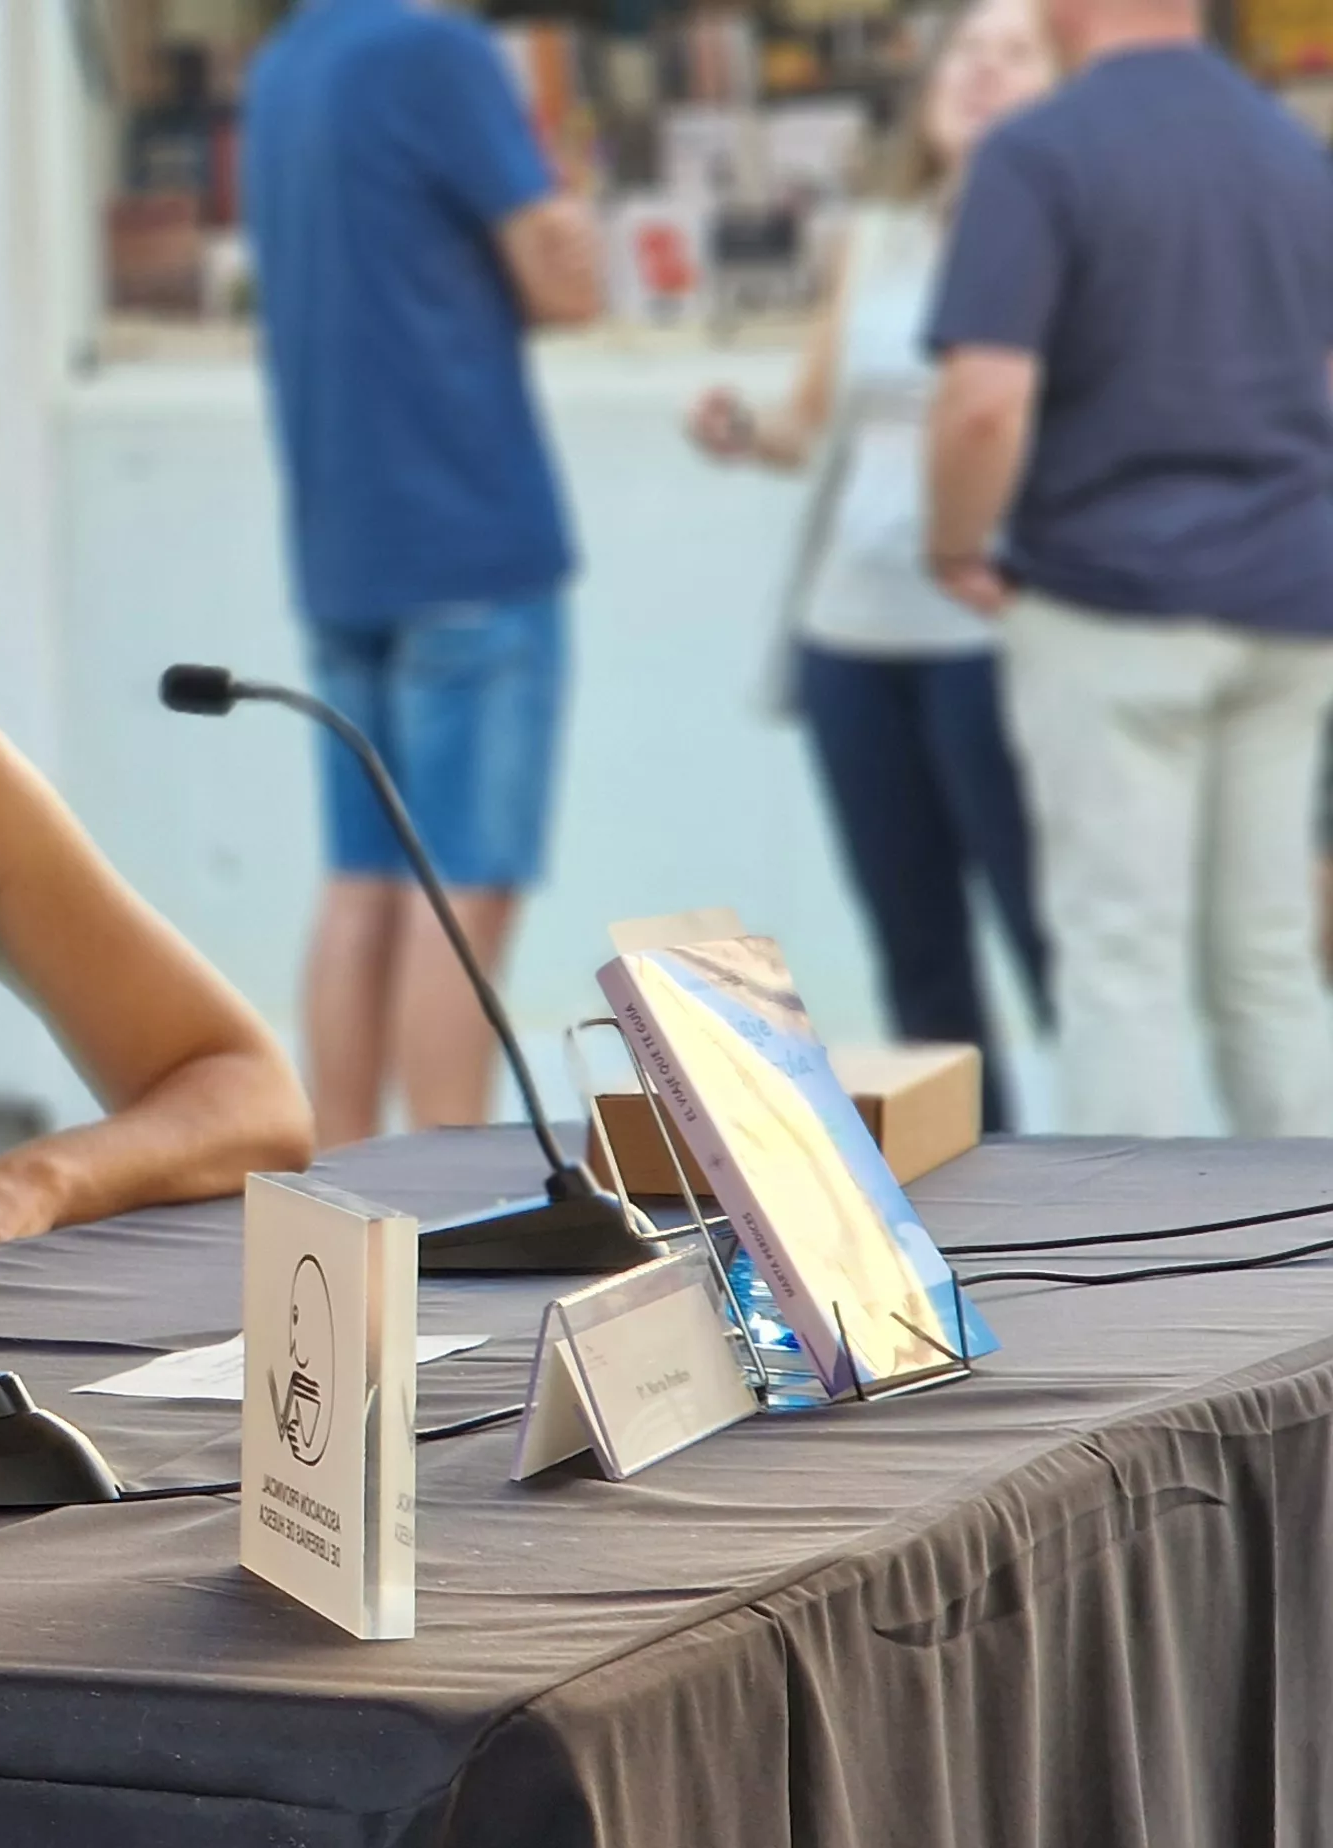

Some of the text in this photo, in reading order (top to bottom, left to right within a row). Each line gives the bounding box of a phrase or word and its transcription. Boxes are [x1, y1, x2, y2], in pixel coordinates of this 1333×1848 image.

[625, 1002, 697, 1122] EL VIAJE QUE TE GUÍA
